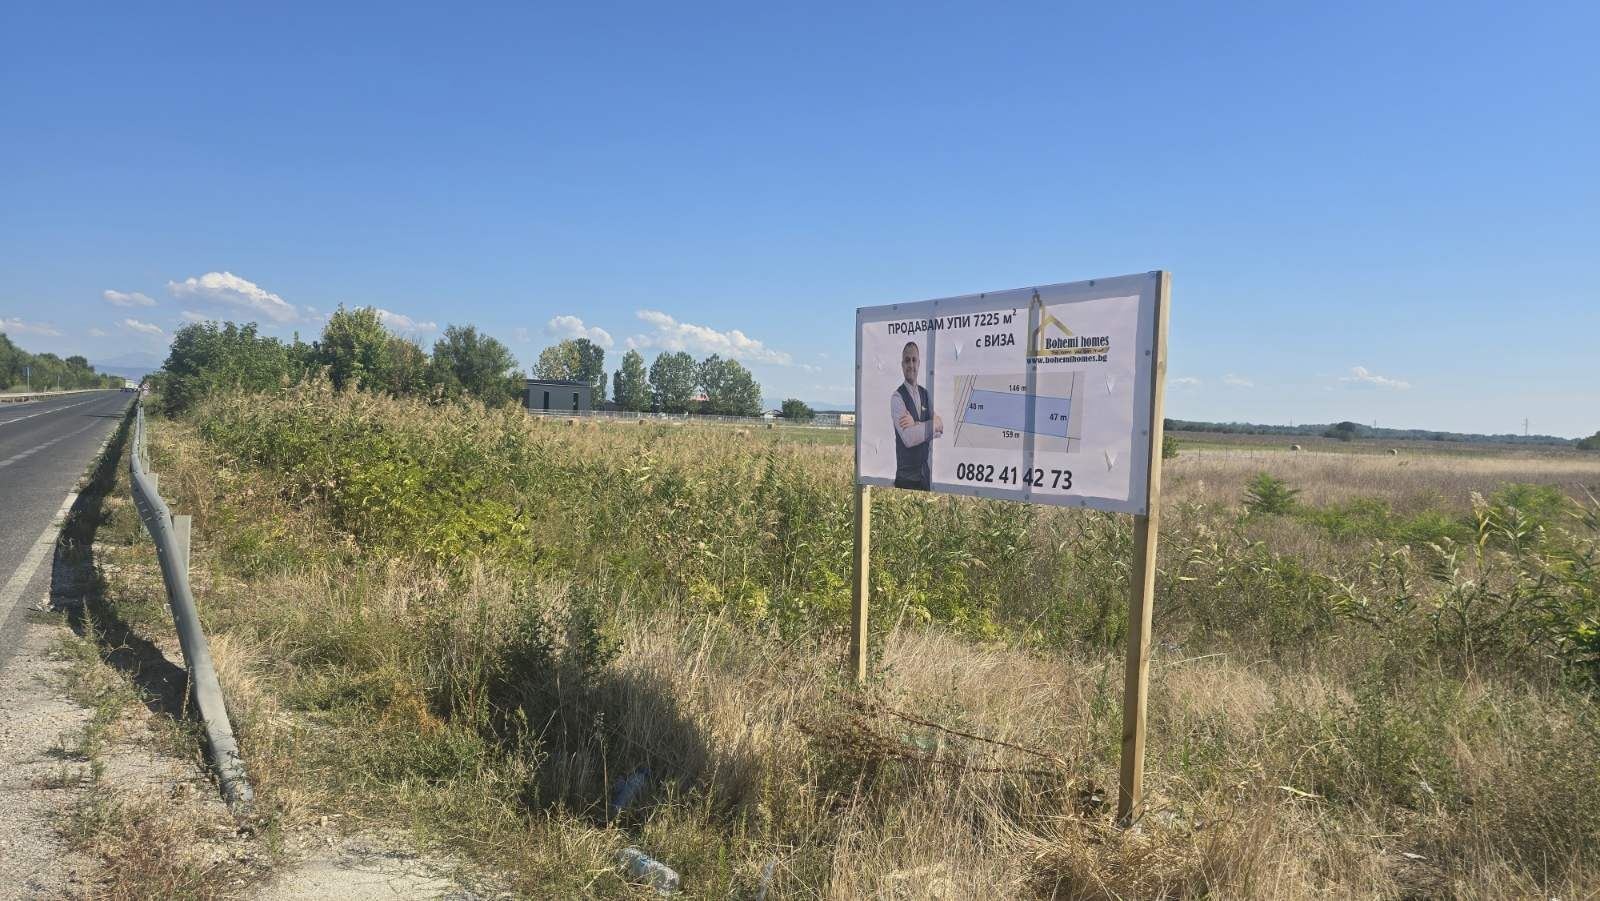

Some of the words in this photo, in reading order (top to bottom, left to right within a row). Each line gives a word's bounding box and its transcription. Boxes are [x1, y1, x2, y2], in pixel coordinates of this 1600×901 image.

[888, 318, 944, 335] ПРОДАВАМ
[947, 315, 971, 330] УПИ
[974, 312, 1000, 327] 7225
[984, 333, 1015, 347] ВИЗА
[1045, 337, 1079, 350] Bohemi
[1081, 335, 1109, 347] homes
[1026, 354, 1108, 365] www.bohemihomes.bg
[1050, 413, 1058, 421] 47
[1002, 430, 1014, 439] 159
[956, 463, 994, 482] 0882
[998, 466, 1017, 485] 41
[1022, 467, 1044, 487] 42
[1051, 469, 1073, 490] 73
